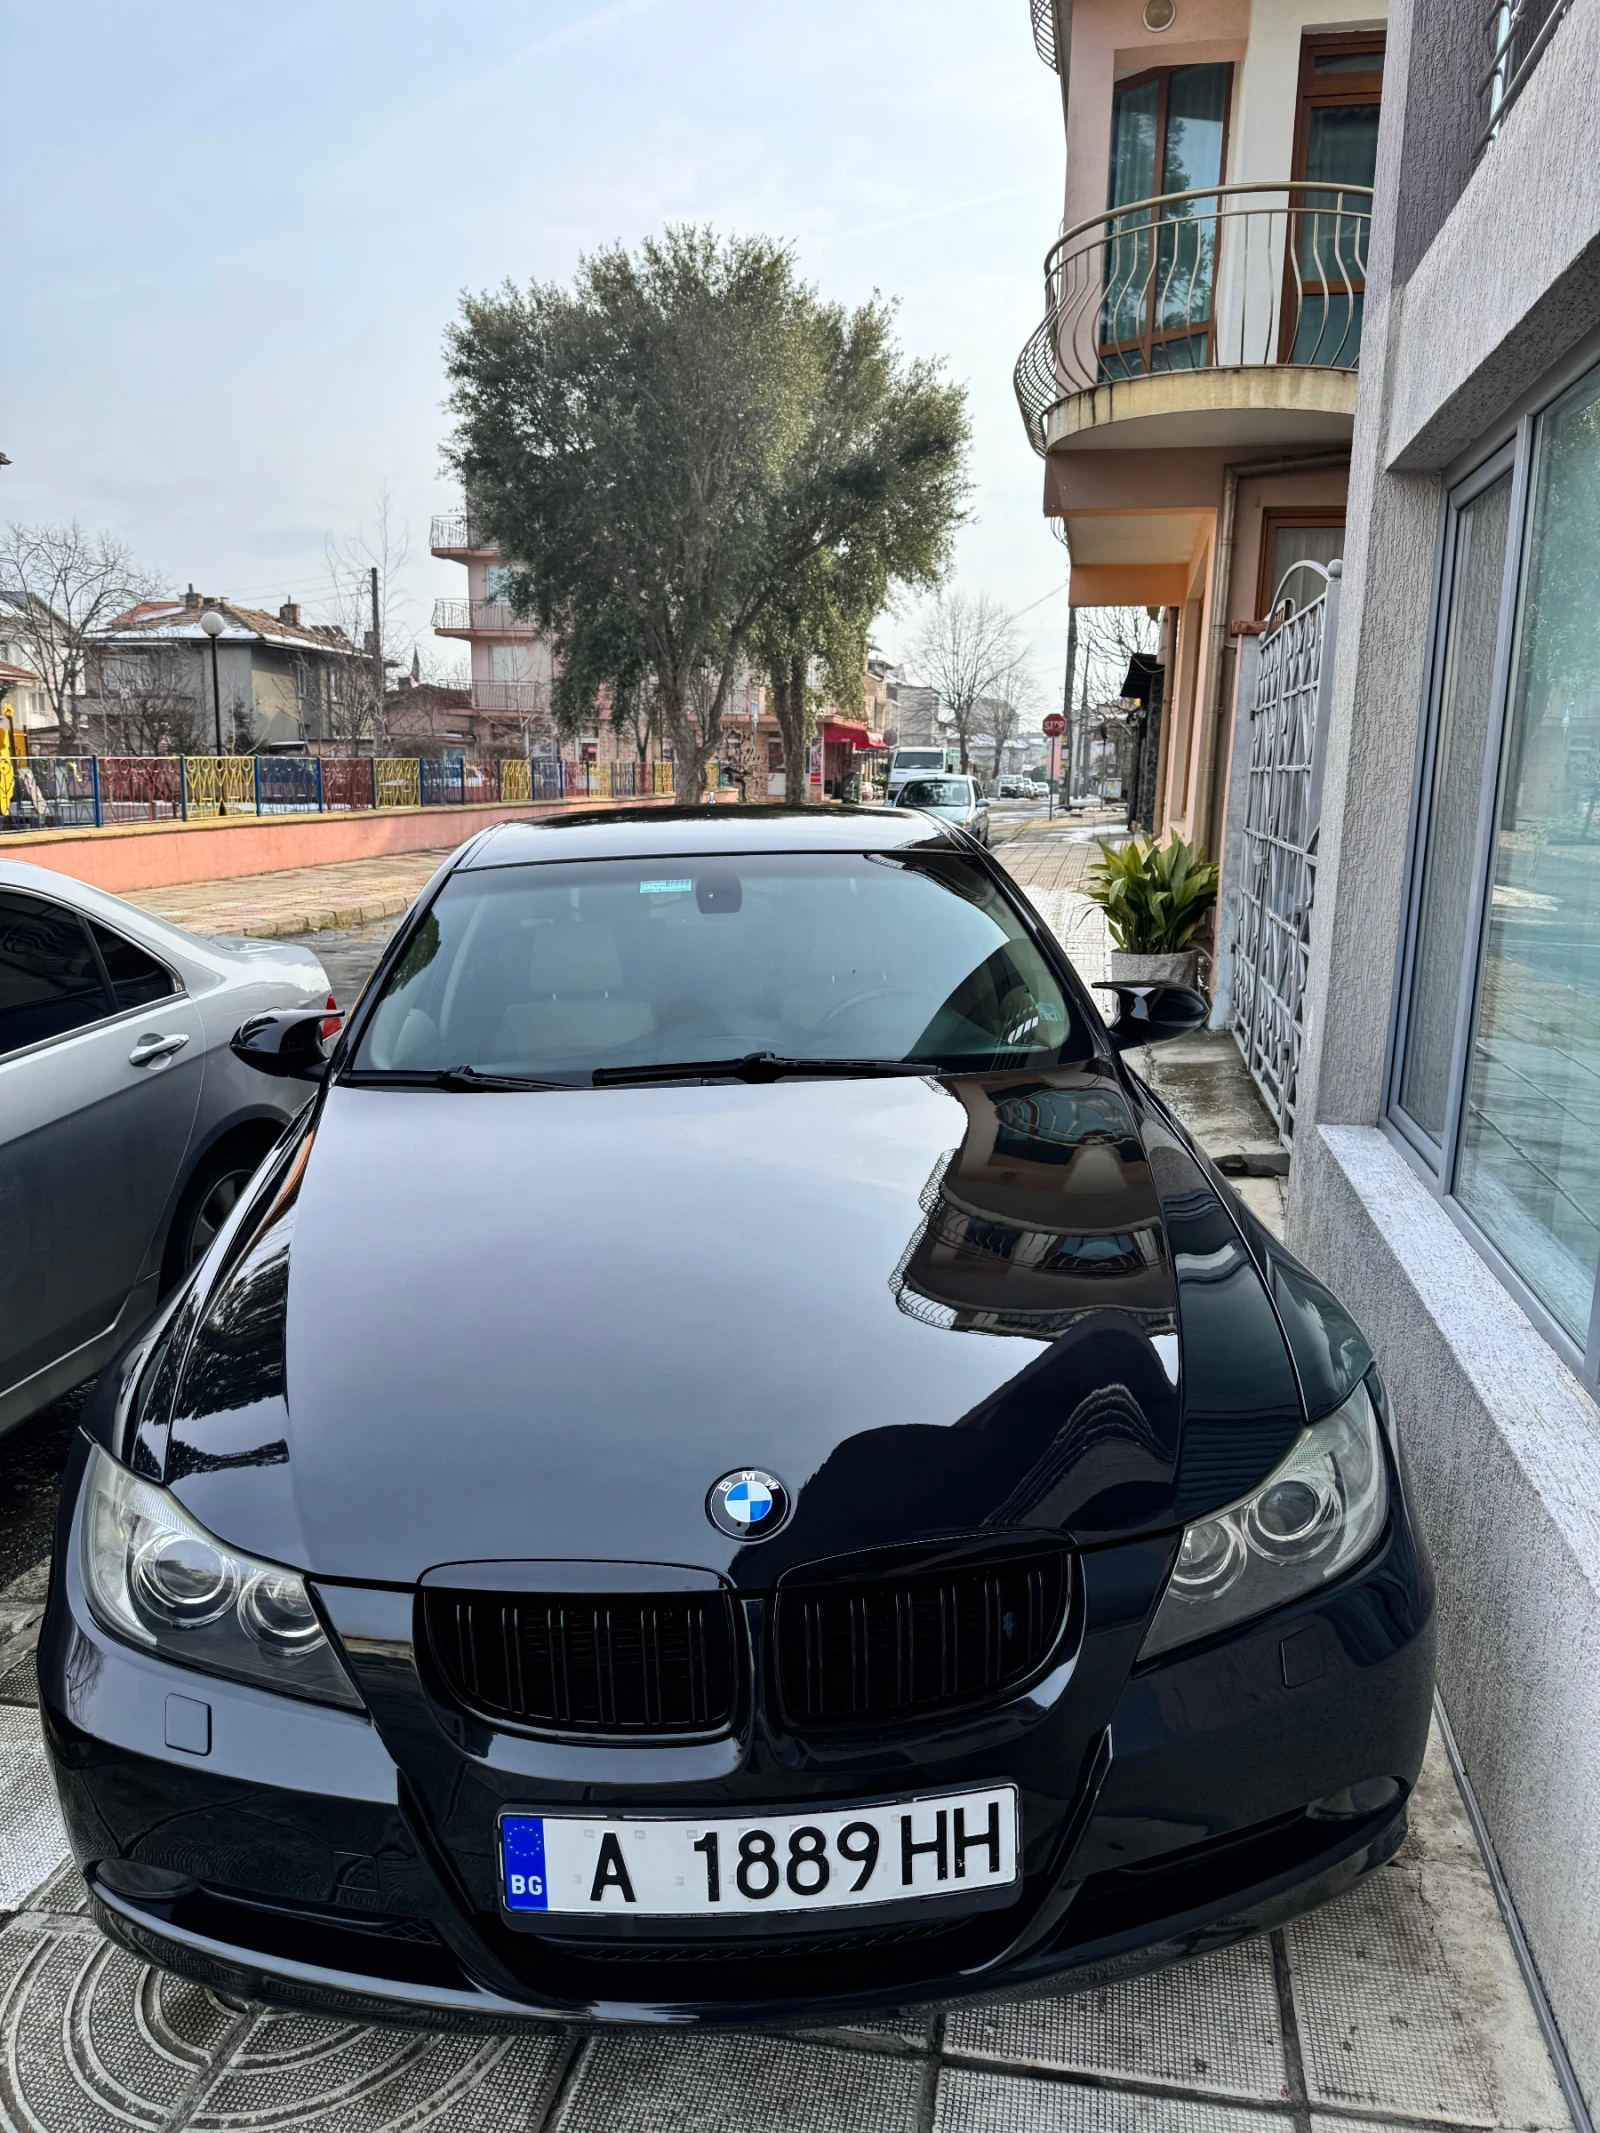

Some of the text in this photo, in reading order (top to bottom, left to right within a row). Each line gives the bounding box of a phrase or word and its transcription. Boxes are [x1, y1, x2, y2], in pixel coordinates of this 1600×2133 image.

[1044, 721, 1064, 730] STOP
[717, 1472, 780, 1492] BMW
[589, 1801, 1000, 1903] A 1889 HH
[511, 1874, 543, 1896] BG
